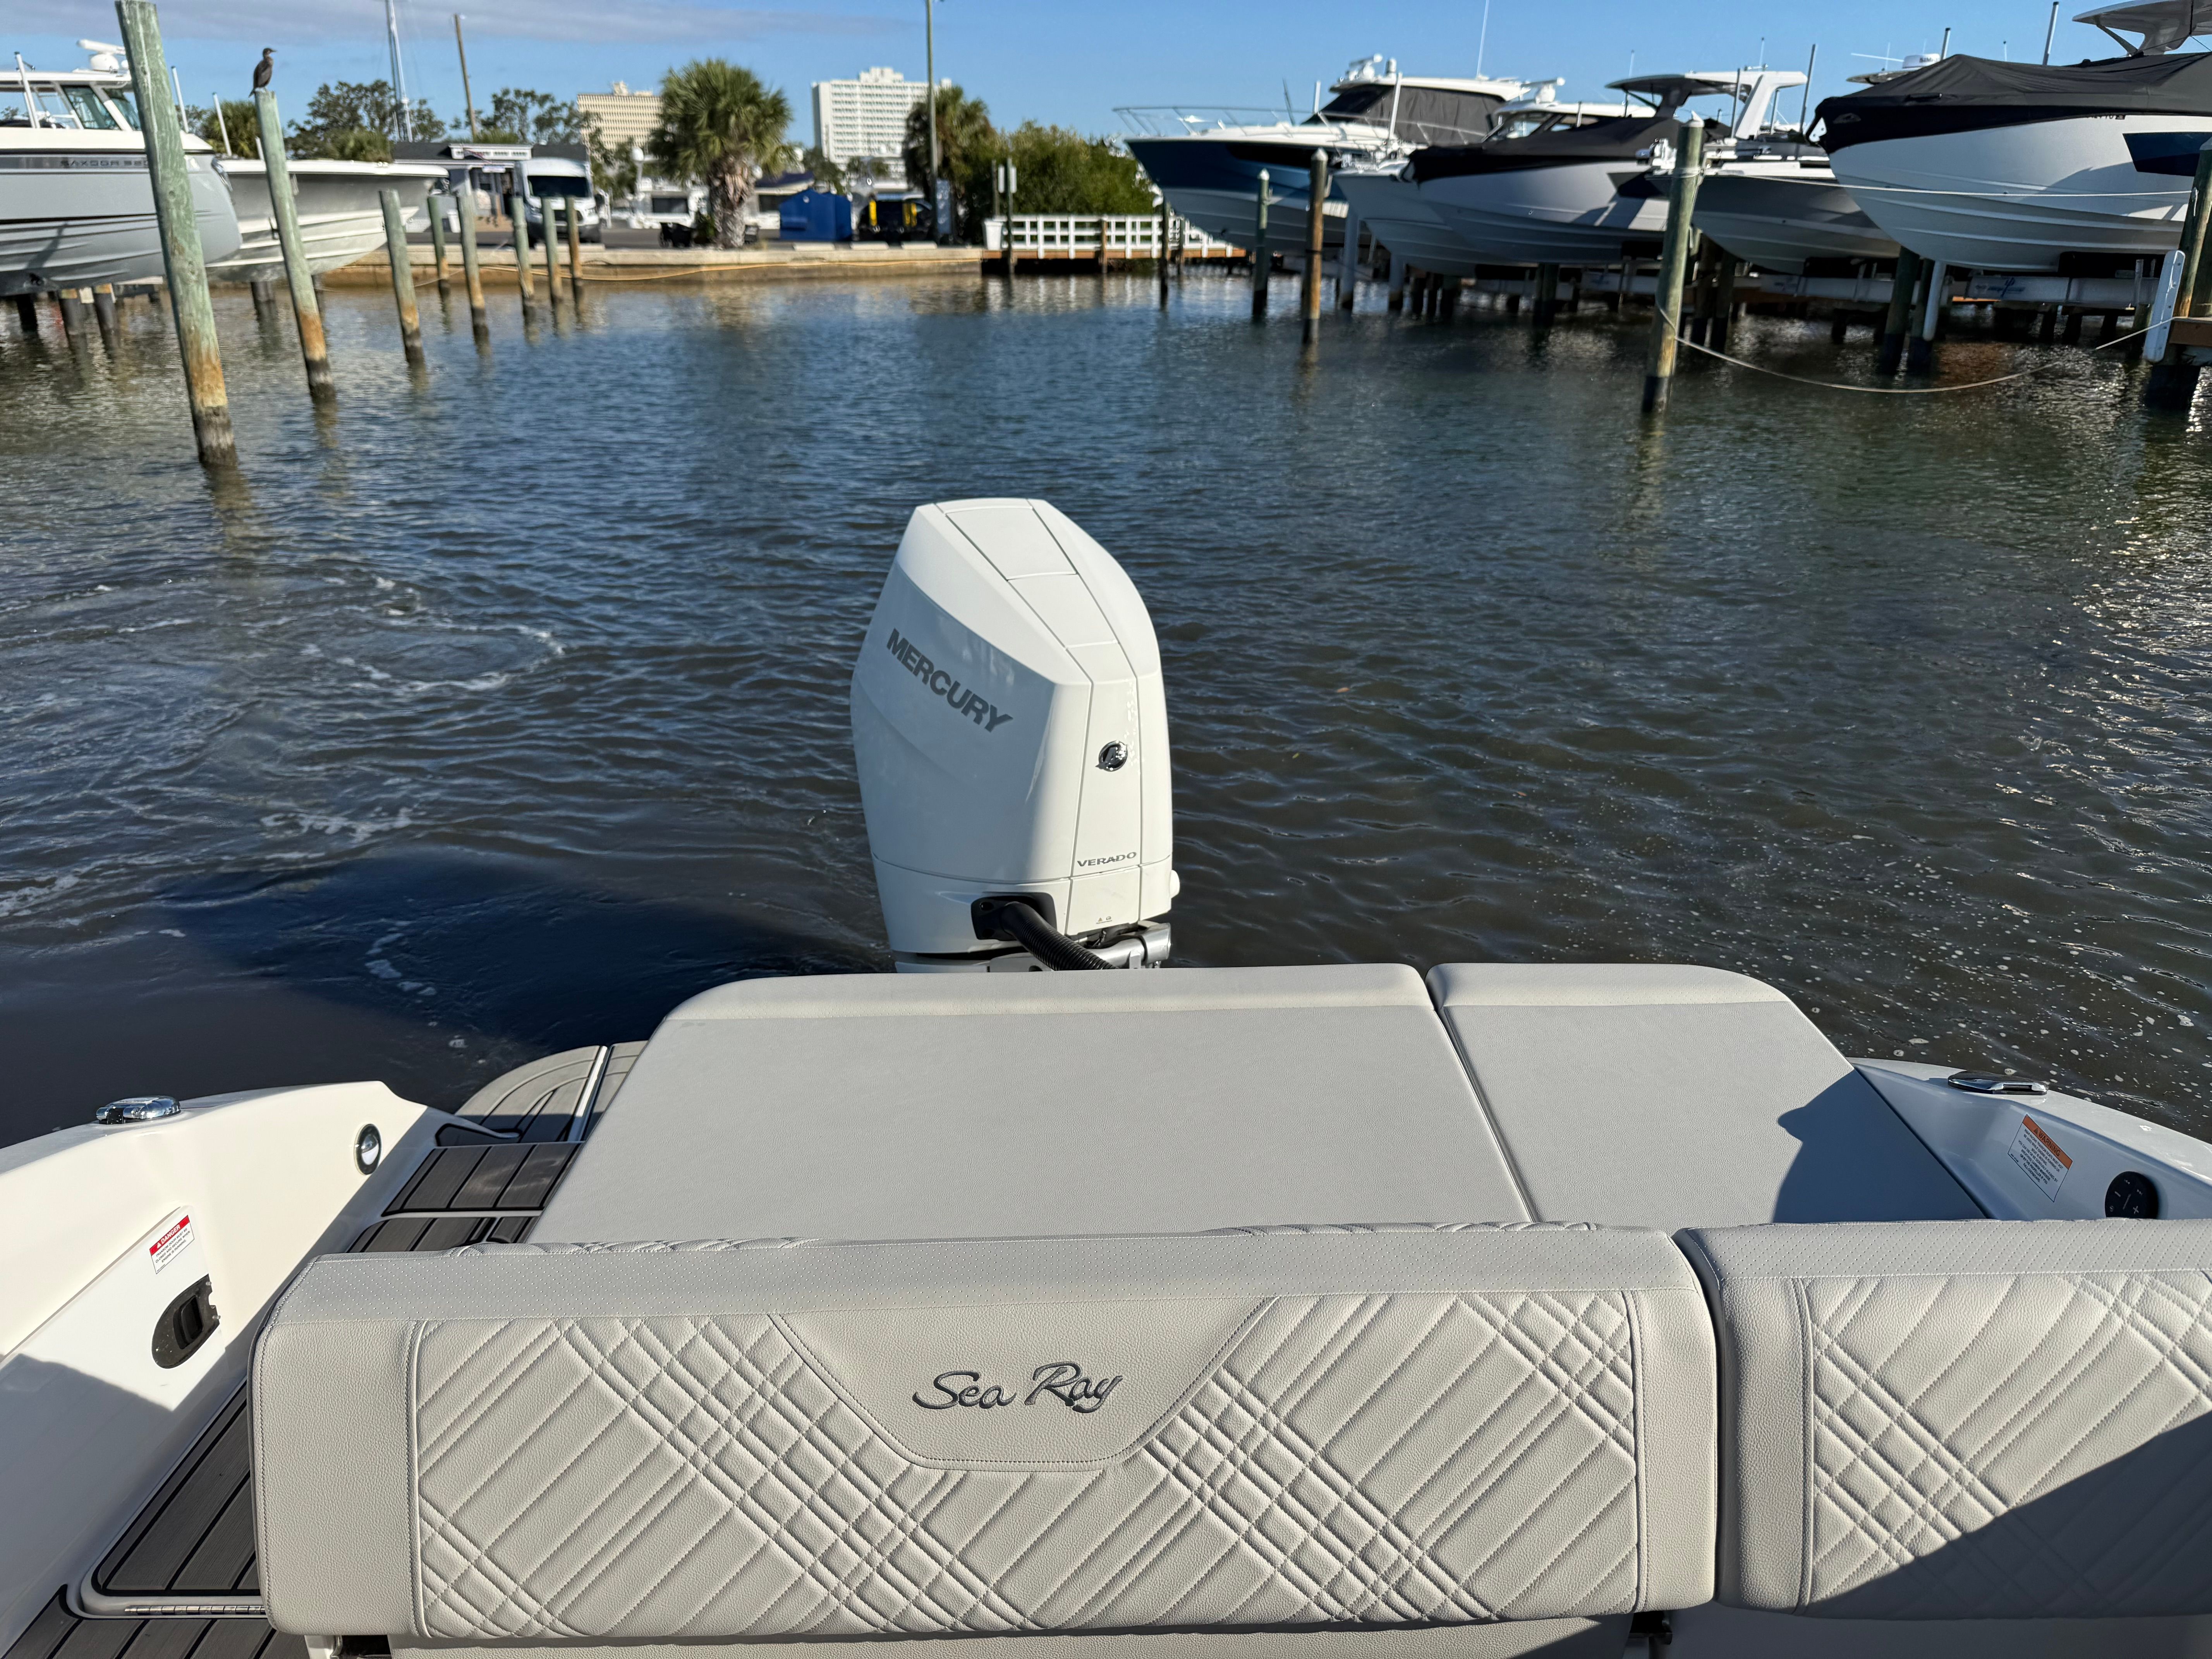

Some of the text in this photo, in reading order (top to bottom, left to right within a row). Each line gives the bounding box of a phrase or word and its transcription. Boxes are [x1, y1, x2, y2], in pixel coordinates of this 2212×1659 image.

[887, 628, 1013, 732] MERCURY
[1077, 852, 1136, 866] VERADO
[2039, 1131, 2061, 1156] WARNING
[161, 1224, 180, 1244] DANGER
[156, 1252, 166, 1263] CLOSED
[172, 1238, 182, 1248] SECURE
[156, 1245, 168, 1257] TRANSOM
[162, 1253, 171, 1262] ENGINE
[912, 1361, 1123, 1413] Sea Ray
